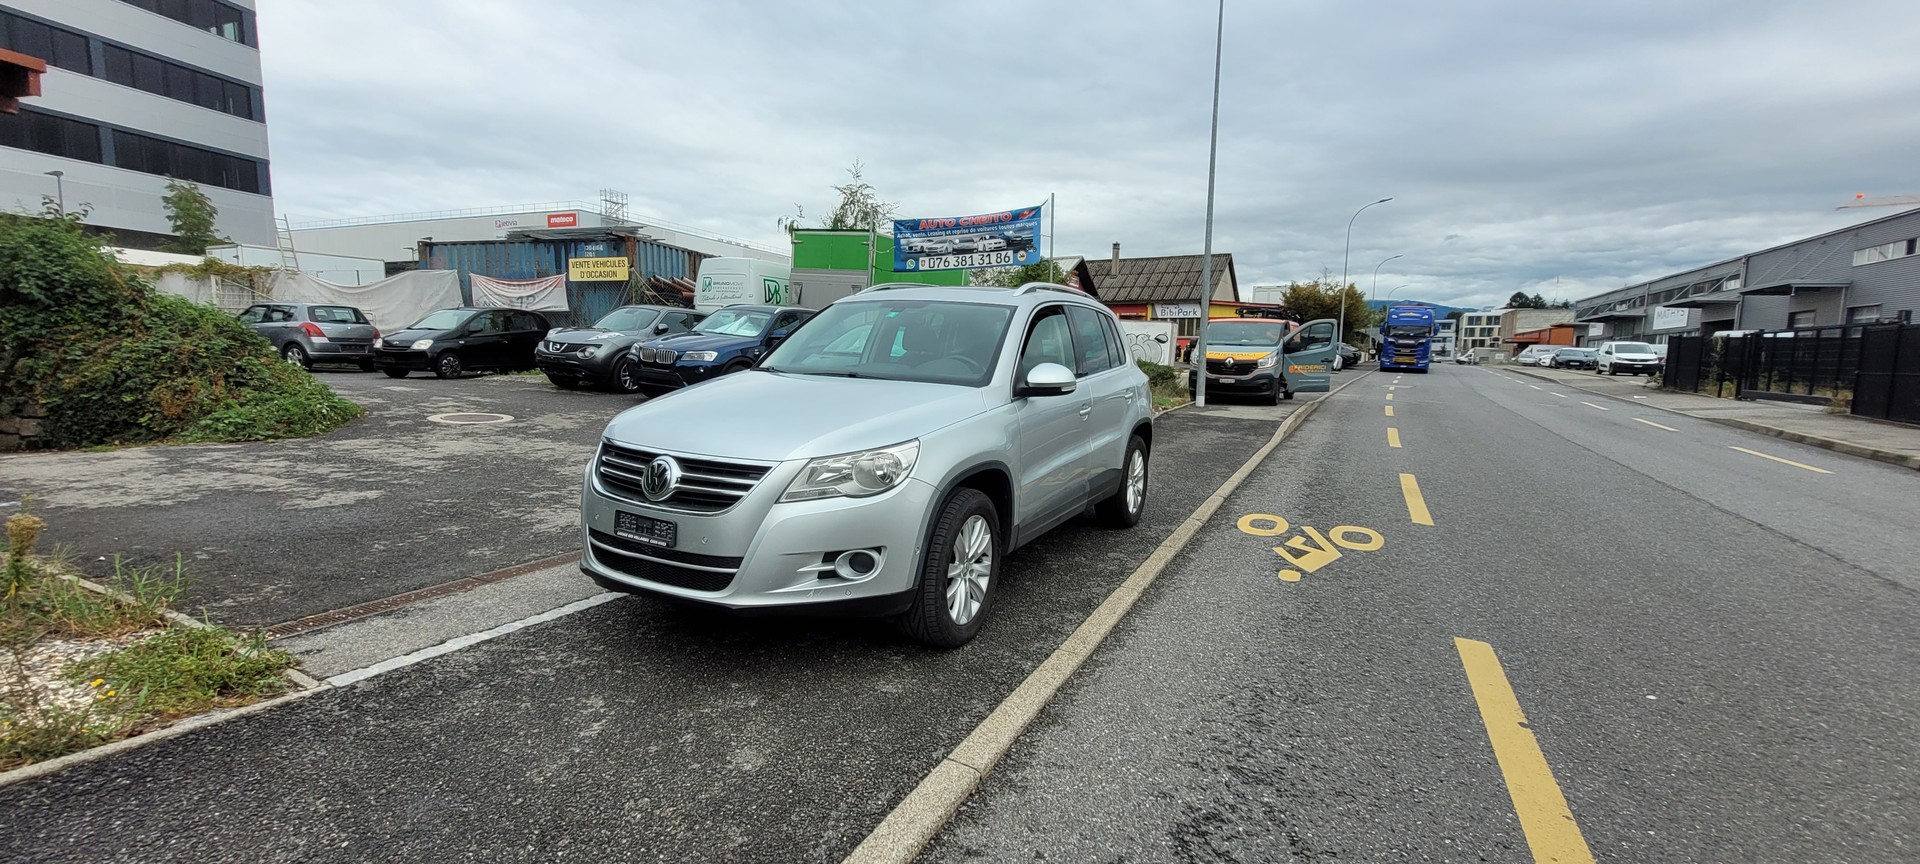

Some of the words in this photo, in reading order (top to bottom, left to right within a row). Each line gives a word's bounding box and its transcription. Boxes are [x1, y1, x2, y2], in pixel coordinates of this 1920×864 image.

[550, 216, 574, 224] mateco
[919, 218, 956, 230] AUTO
[952, 228, 969, 236] reprise
[998, 222, 1015, 230] toutes
[1015, 220, 1038, 229] marques
[571, 260, 591, 269] VENTE
[592, 259, 626, 269] VEHICULES
[928, 256, 950, 269] 076
[953, 254, 975, 267] 381
[978, 253, 993, 266] 31
[996, 251, 1011, 264] 86
[580, 270, 618, 279] D'OCCASION
[1160, 308, 1198, 317] BibiPark
